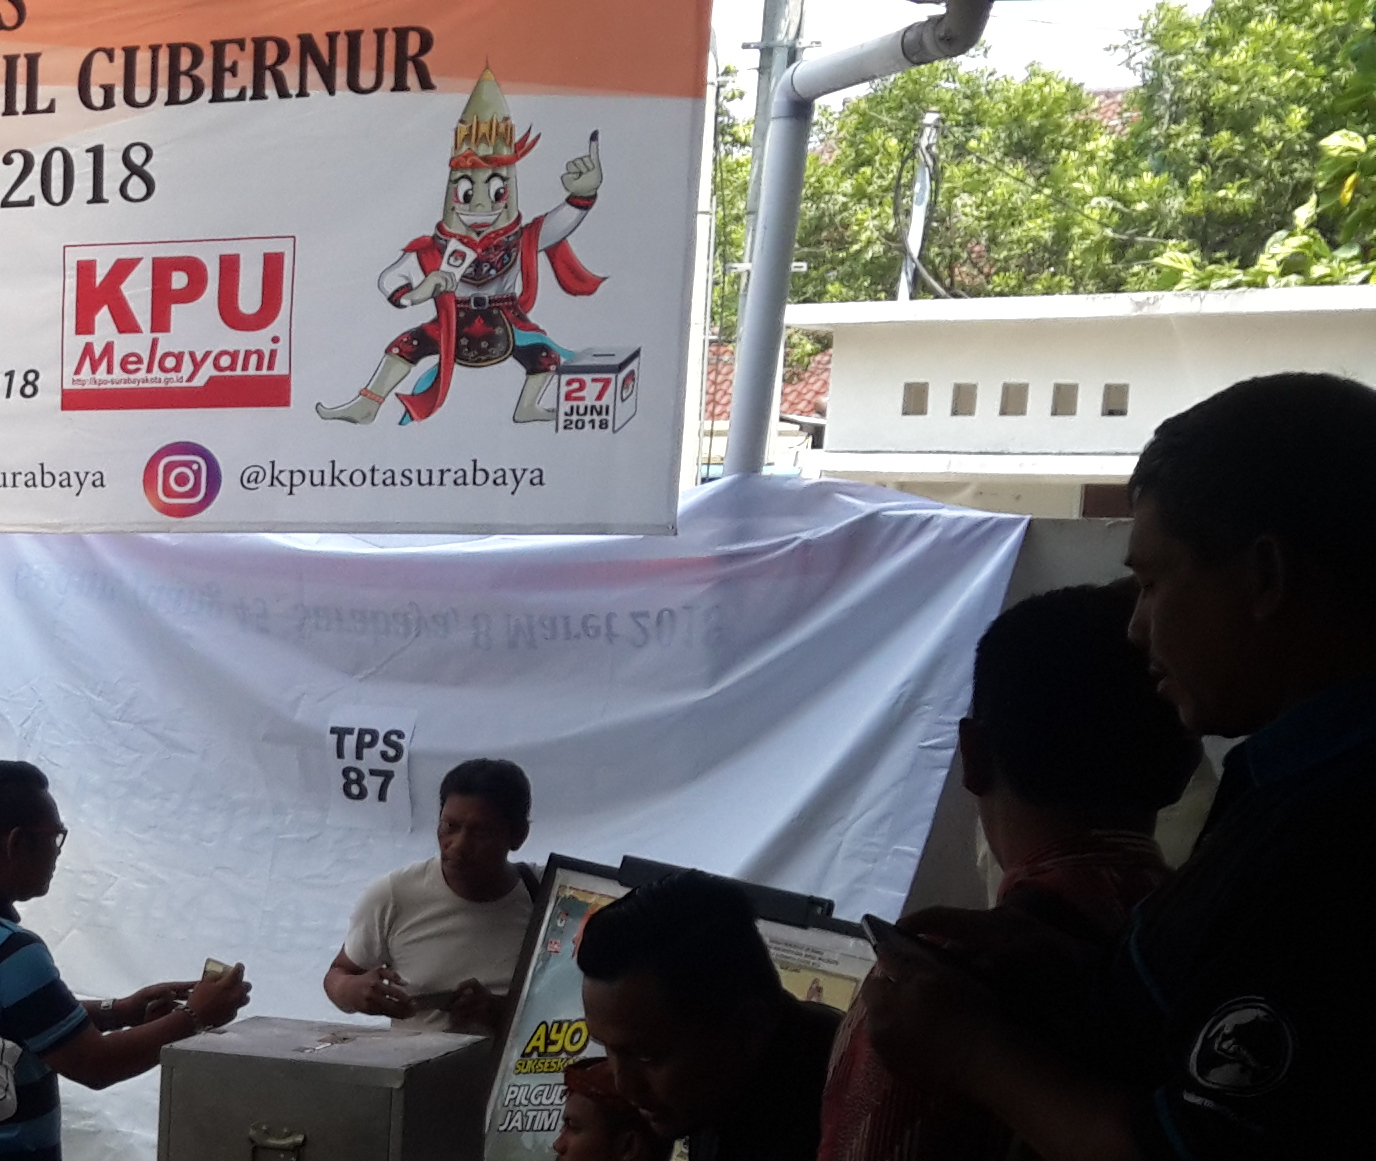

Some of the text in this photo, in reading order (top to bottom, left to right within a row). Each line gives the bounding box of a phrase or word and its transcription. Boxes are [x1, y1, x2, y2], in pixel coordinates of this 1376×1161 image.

[77, 25, 437, 113] GUBERNUR
[1, 141, 157, 208] 2018
[74, 251, 286, 336] KPU
[73, 335, 280, 383] Melayani
[563, 376, 613, 403] 27
[562, 417, 610, 432] 2018
[563, 403, 611, 418] JUNI
[239, 459, 547, 495] @kpukotasurabaya
[330, 726, 405, 763] TPS
[342, 766, 395, 802] 87
[521, 1019, 590, 1057] AYO
[514, 1058, 574, 1074] SUKSESK
[498, 1109, 561, 1132] JATIM
